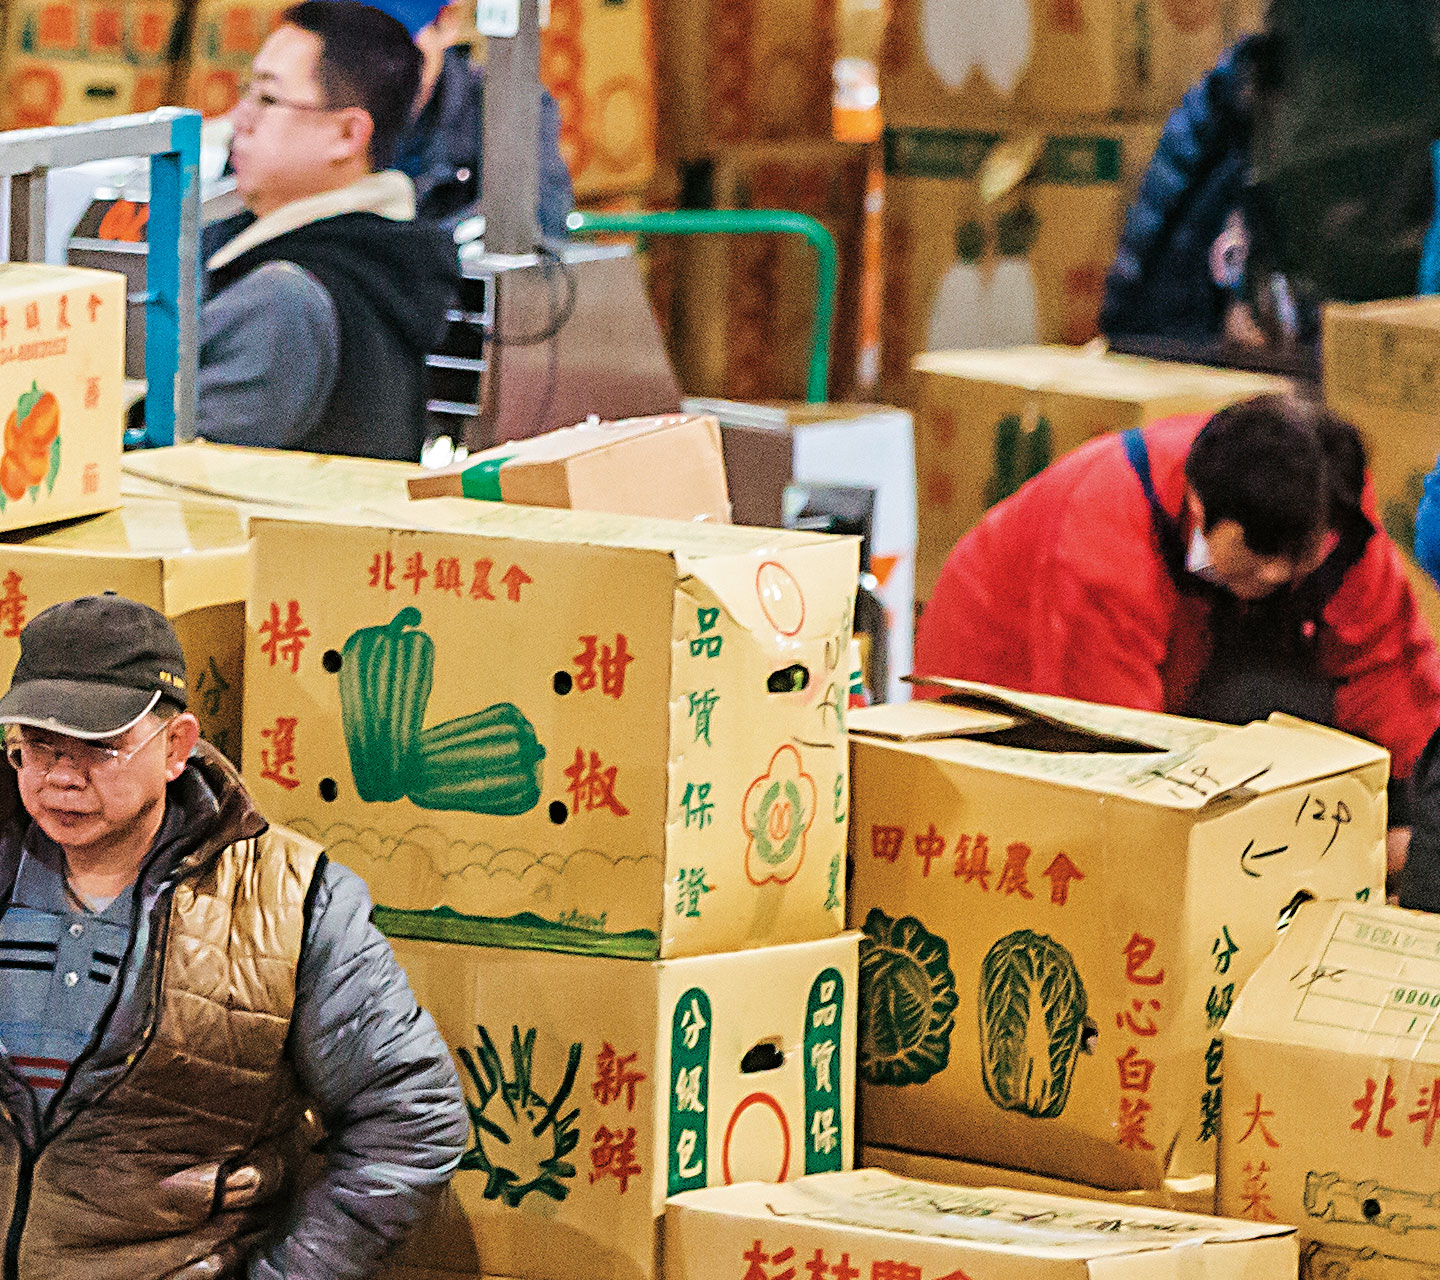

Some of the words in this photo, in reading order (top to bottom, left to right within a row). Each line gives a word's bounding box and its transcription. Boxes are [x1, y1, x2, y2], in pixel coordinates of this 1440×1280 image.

[369, 552, 532, 601] 北斗鎮農會
[260, 601, 310, 790] 特選
[565, 634, 633, 816] 甜椒
[677, 607, 723, 917] 品質保證
[871, 824, 1084, 905] 田中鎮農會
[589, 1043, 646, 1193] 新鮮
[1115, 933, 1164, 1150] 包心白菜
